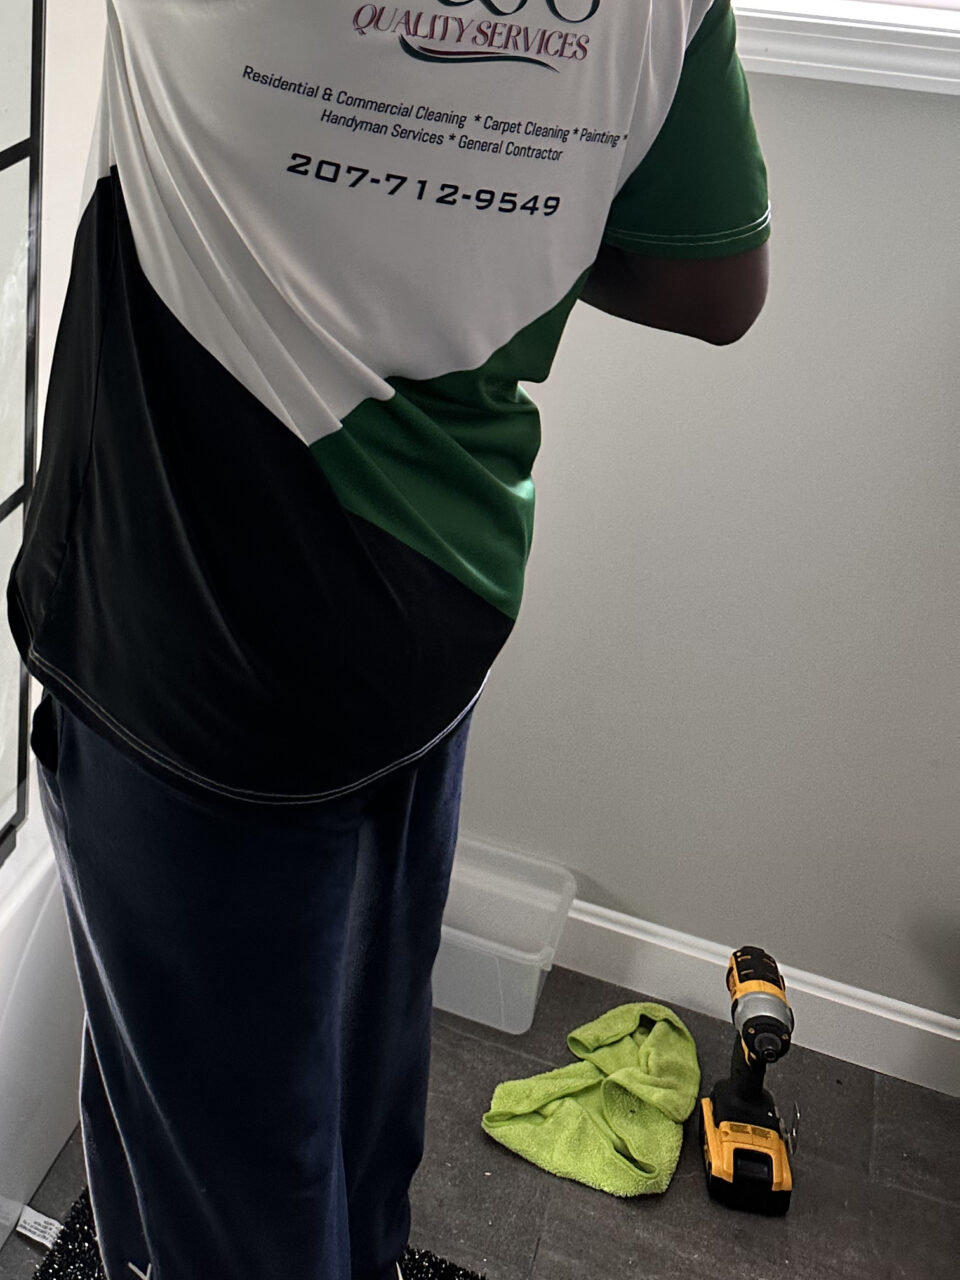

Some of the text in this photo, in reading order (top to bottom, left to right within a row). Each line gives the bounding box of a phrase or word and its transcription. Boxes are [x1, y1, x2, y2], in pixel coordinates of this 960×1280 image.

[352, 3, 590, 61] QUALITY SERVICES
[242, 65, 621, 148] Residential & Commercial Cleaning Carpet Cleaning Painting
[320, 109, 564, 162] Handyman Services General Contractor
[286, 152, 561, 217] 207-712-9549
